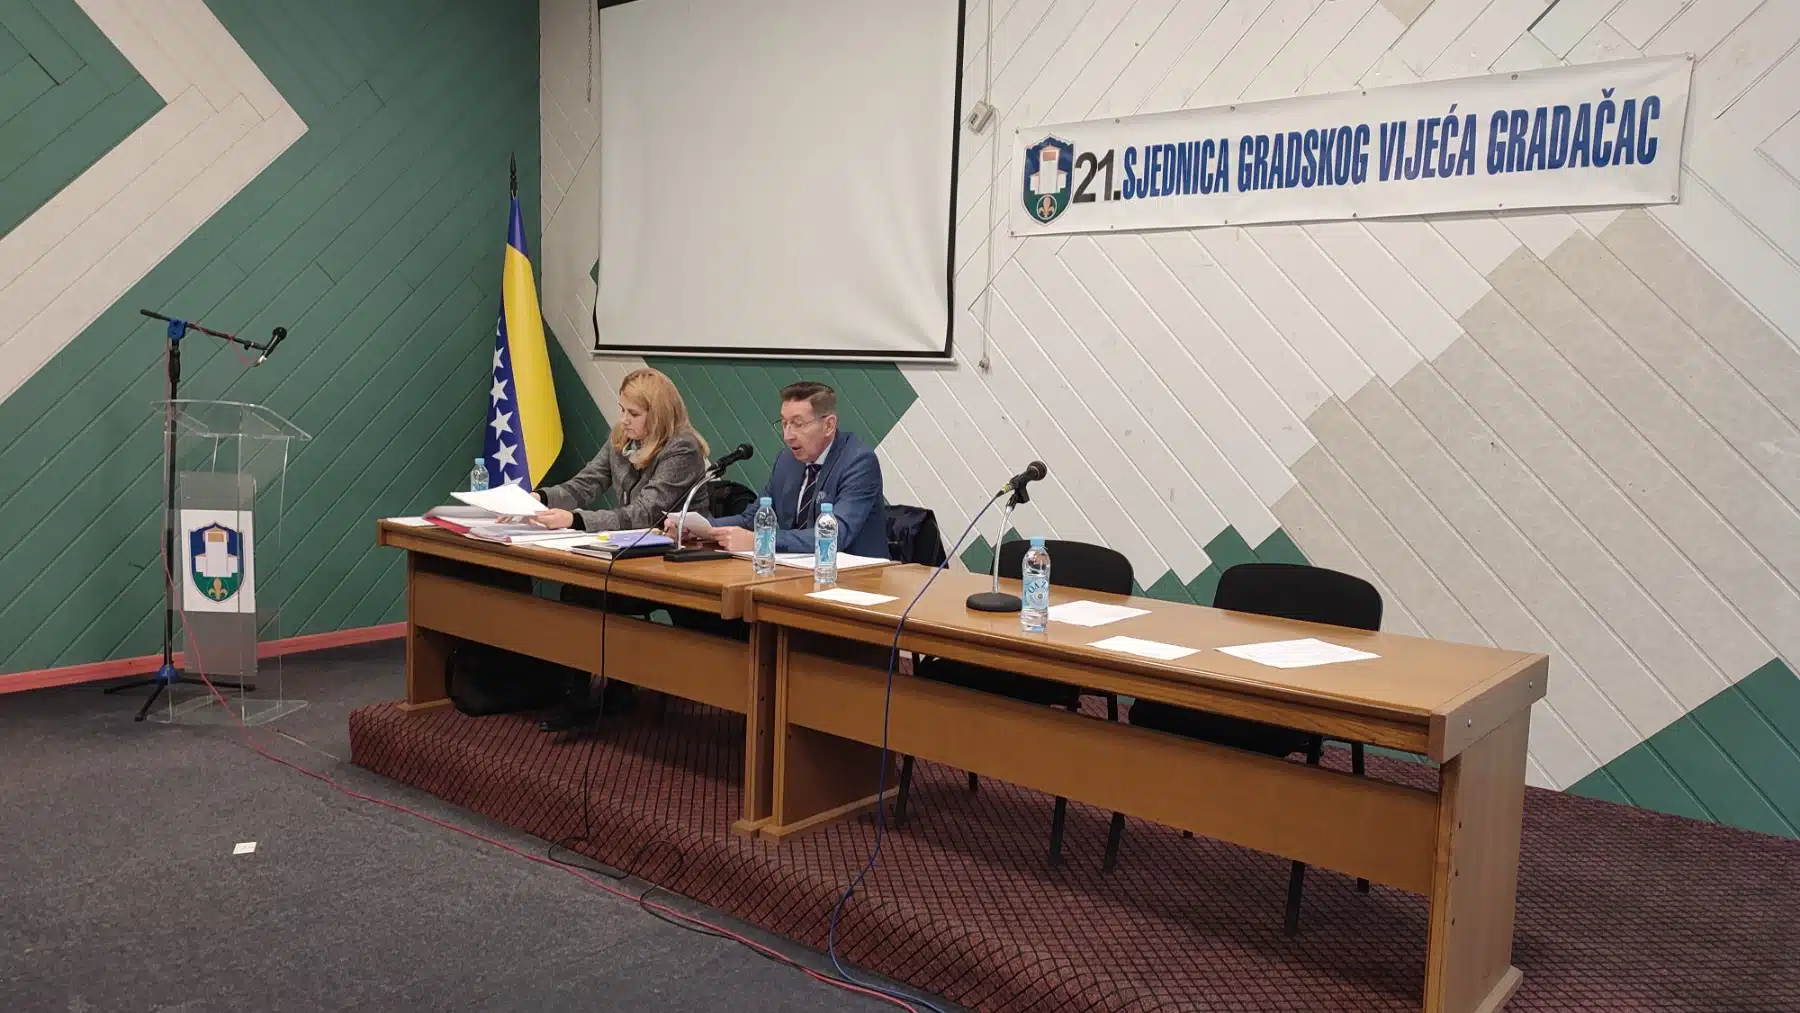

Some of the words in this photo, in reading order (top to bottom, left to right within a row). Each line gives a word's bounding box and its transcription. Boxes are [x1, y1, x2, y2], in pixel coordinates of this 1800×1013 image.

[1123, 138, 1229, 200] SJEDNICA
[1237, 123, 1371, 193] GRADSKOG
[1379, 103, 1477, 182] VIJEĆA
[1486, 87, 1661, 175] GRADAČAC
